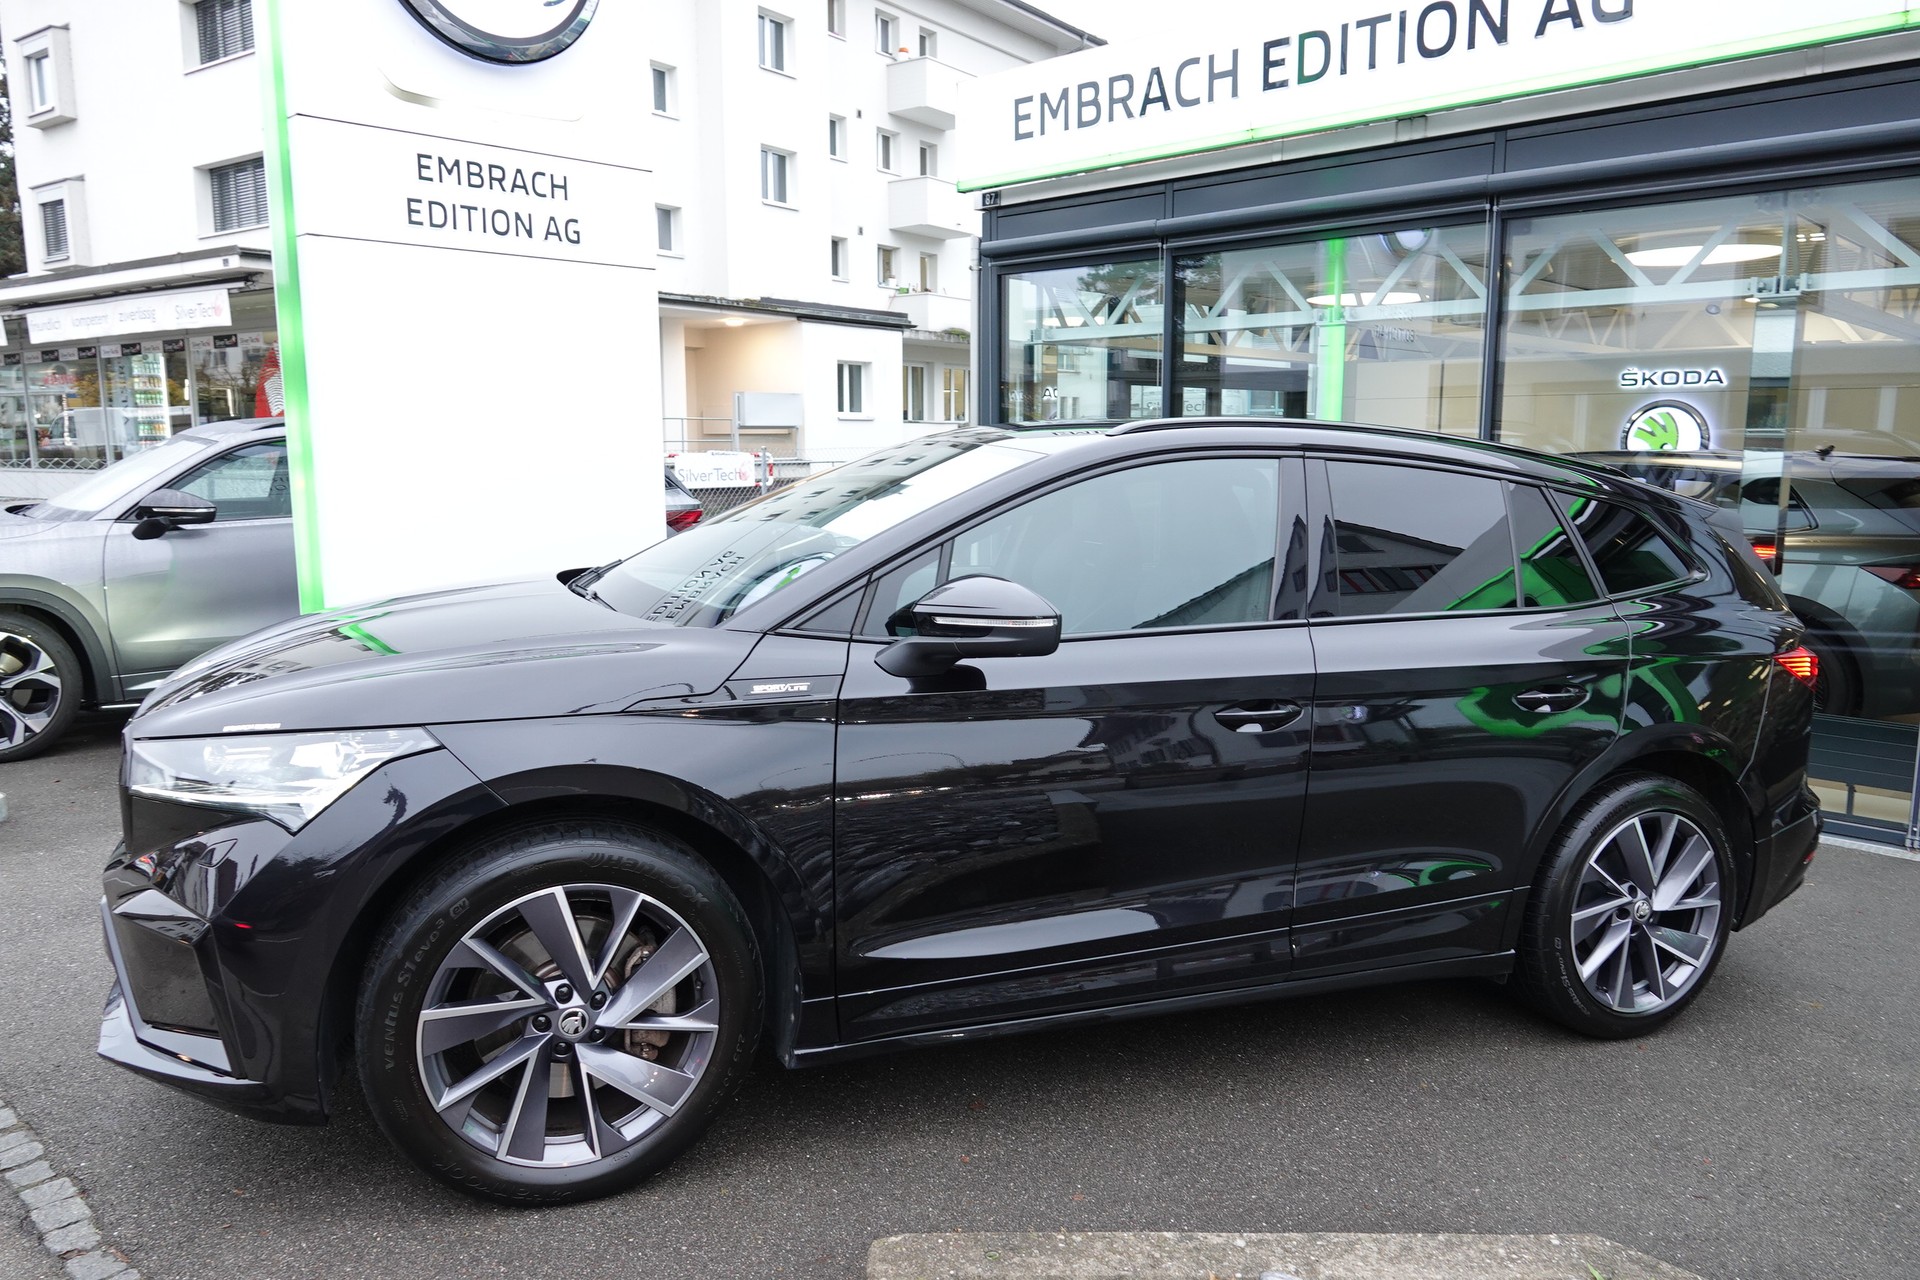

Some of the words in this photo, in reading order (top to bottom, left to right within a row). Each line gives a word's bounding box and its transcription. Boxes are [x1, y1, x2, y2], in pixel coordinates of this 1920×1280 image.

[1014, 48, 1239, 141] EMBRACH
[1262, 0, 1508, 91] EDITION
[417, 153, 568, 200] EMBRACH
[985, 193, 995, 205] 87
[406, 197, 533, 239] EDITION
[544, 215, 581, 245] AG
[1620, 367, 1724, 387] ŠKODA
